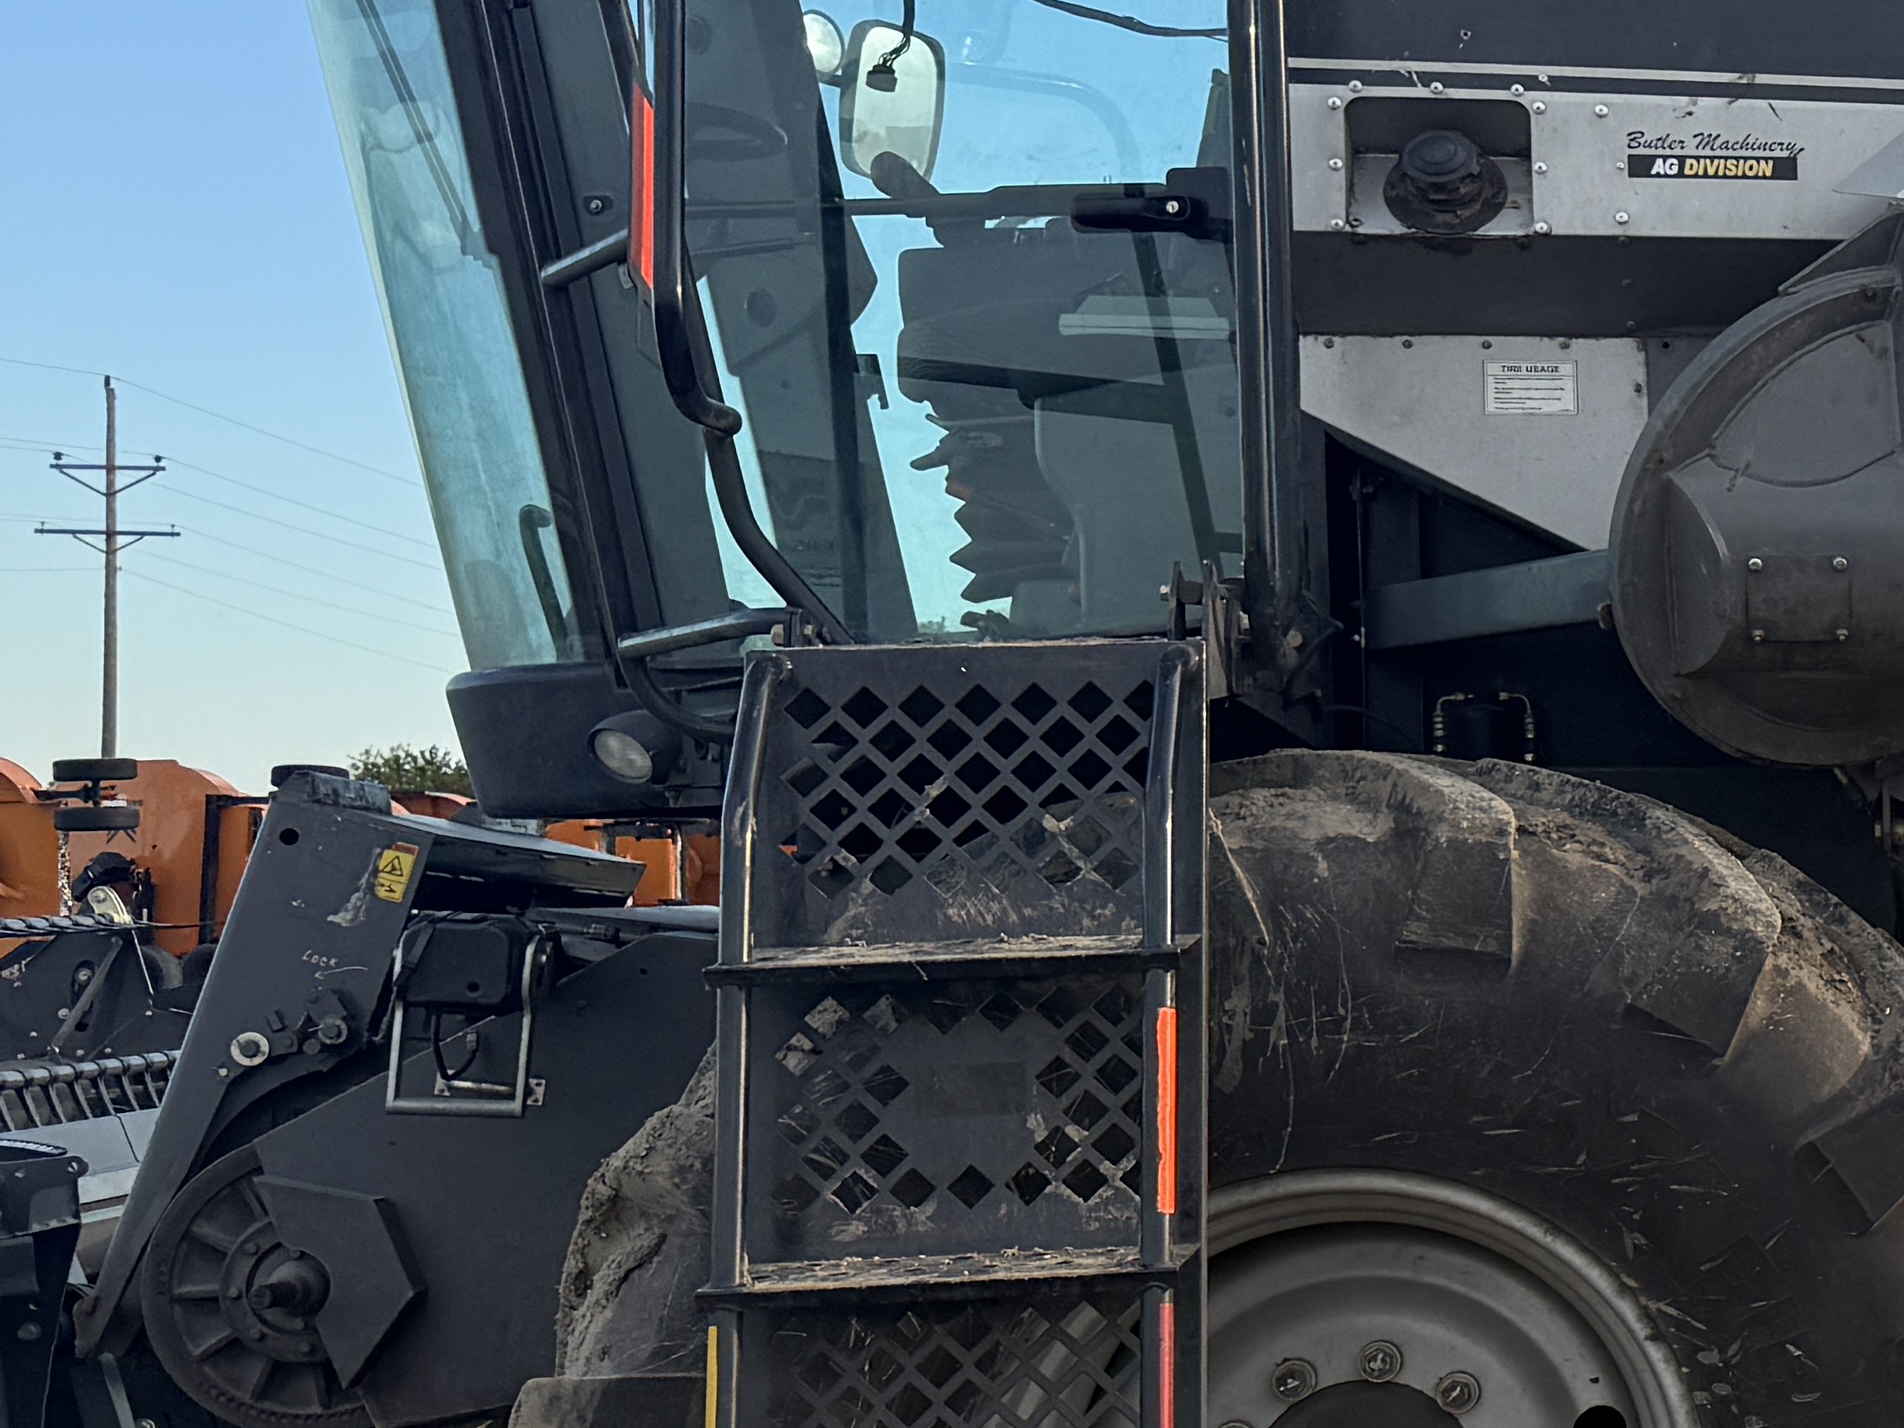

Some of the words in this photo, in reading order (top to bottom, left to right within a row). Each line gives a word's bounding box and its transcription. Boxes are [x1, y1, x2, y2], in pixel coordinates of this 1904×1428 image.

[1626, 131, 1688, 151] Butler
[1692, 132, 1805, 158] Machinery
[1650, 158, 1679, 175] AG
[1683, 158, 1774, 177] DIVISION
